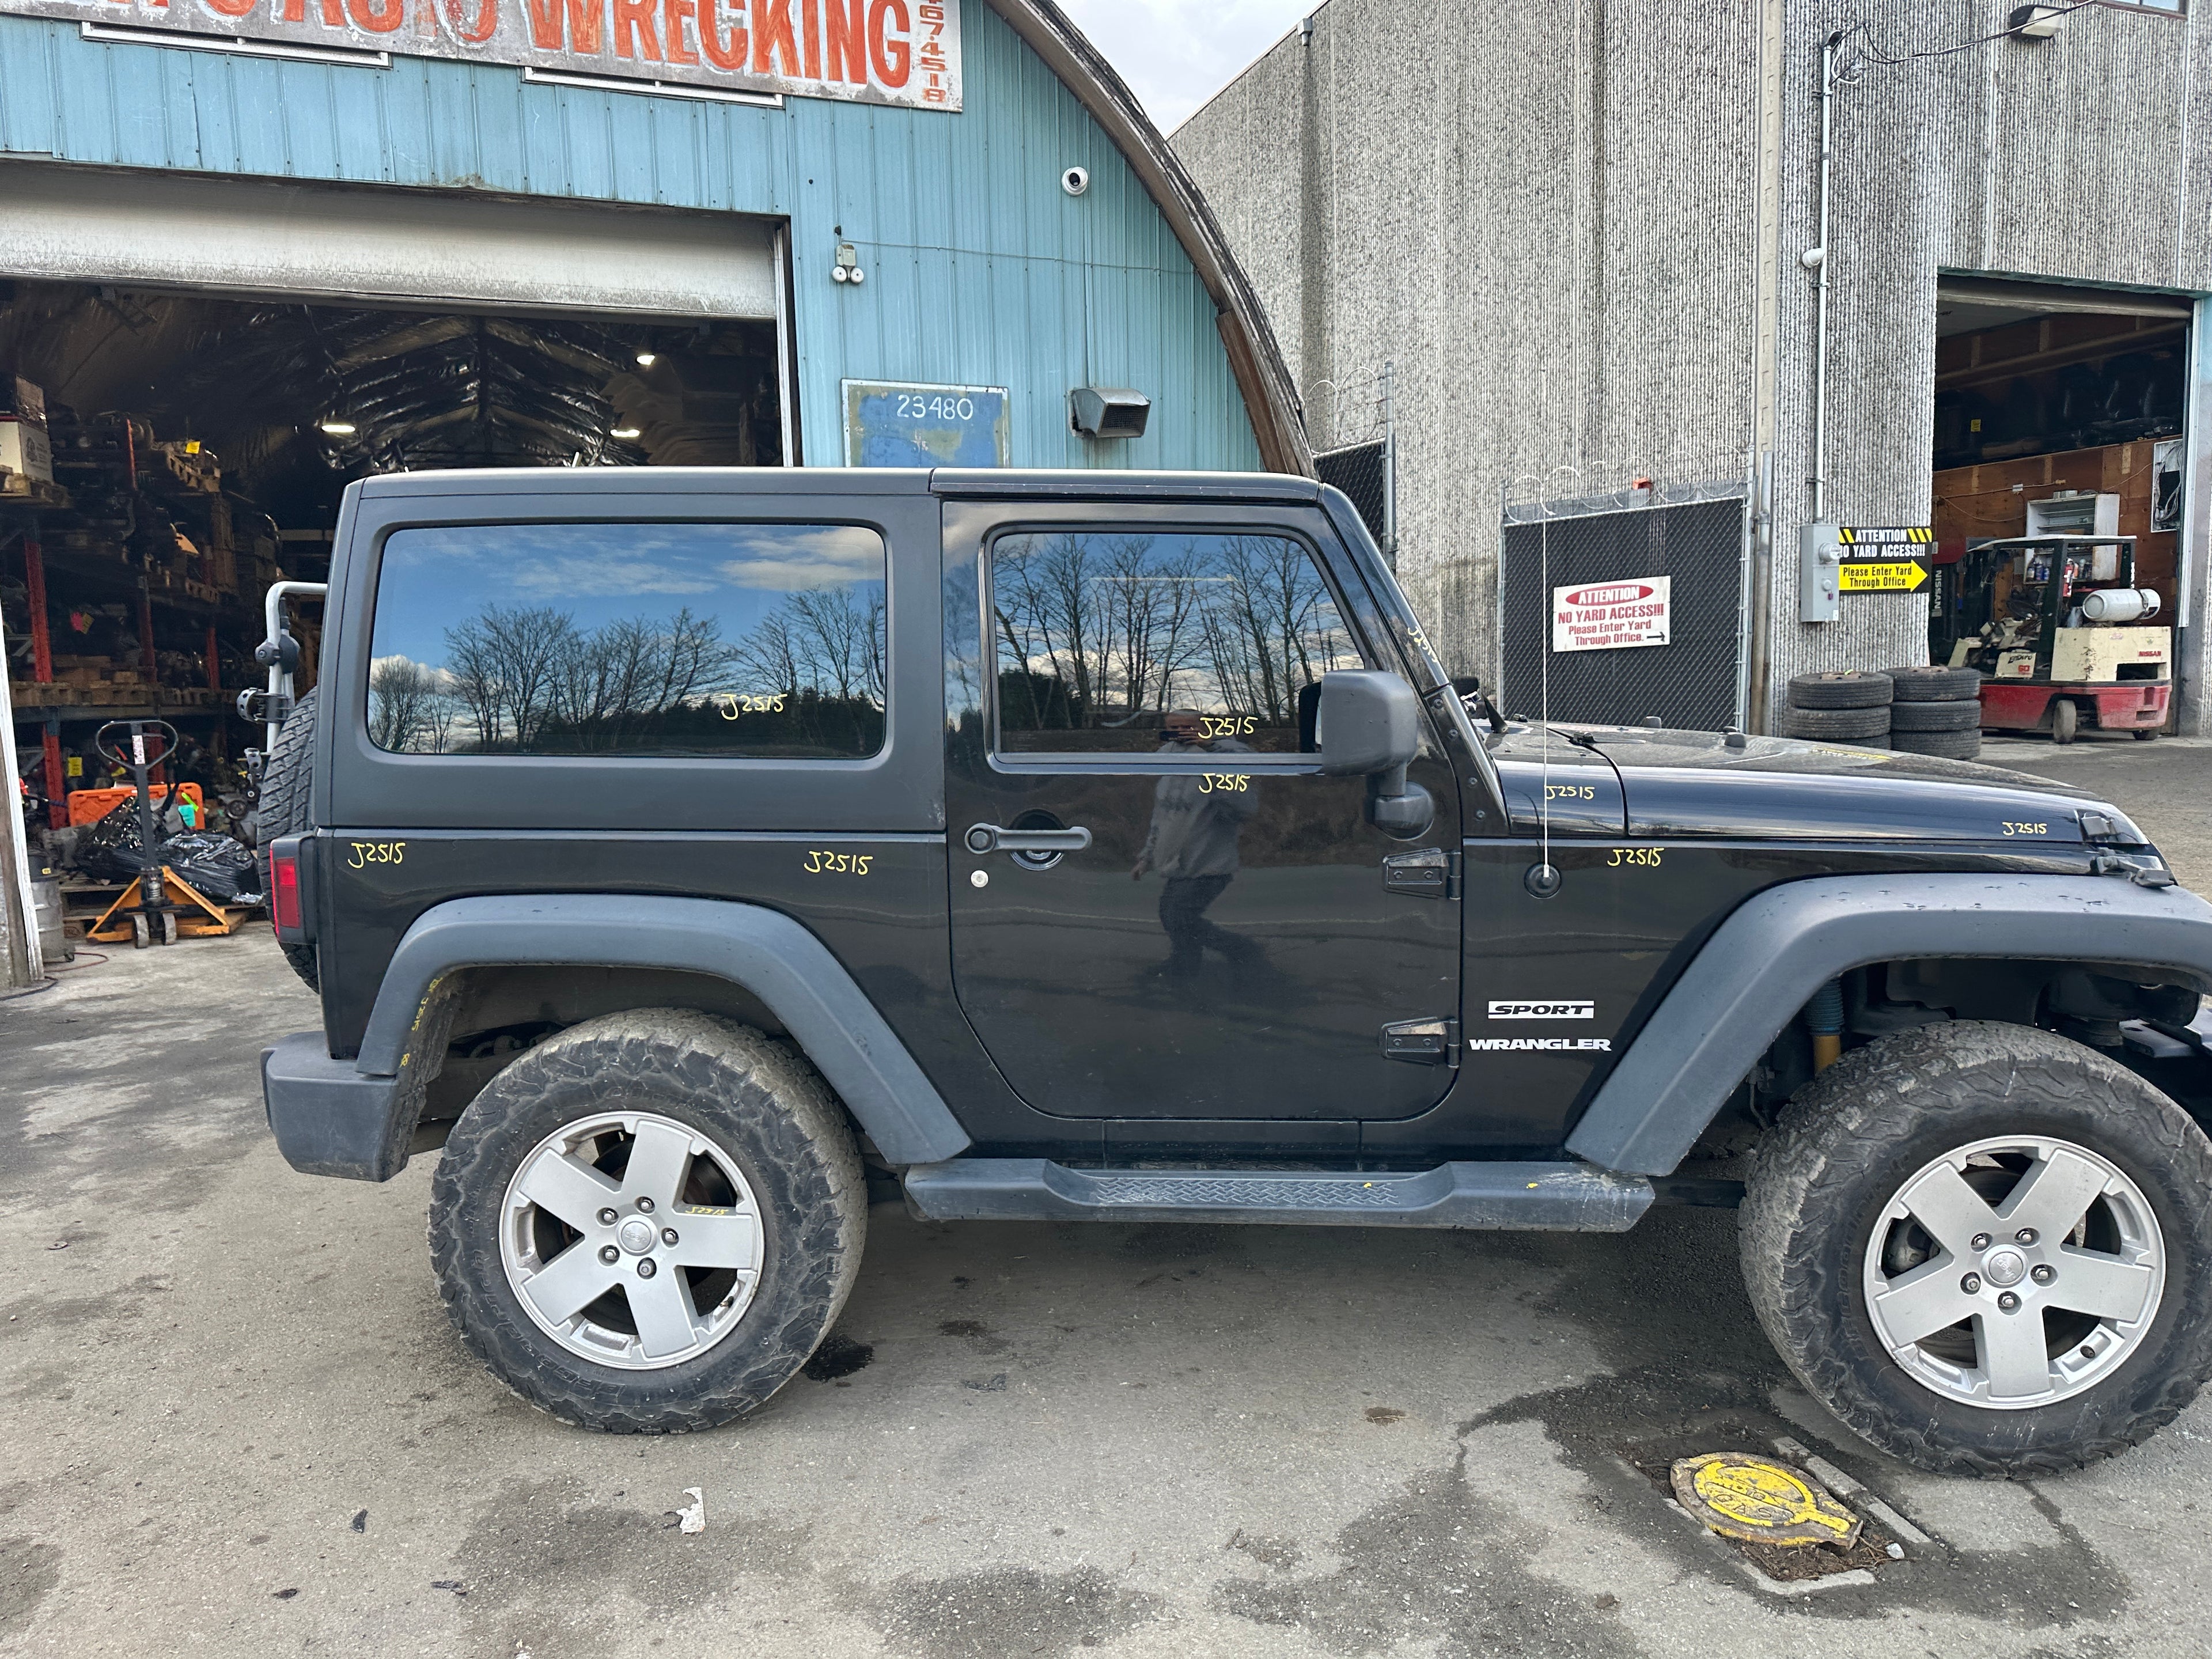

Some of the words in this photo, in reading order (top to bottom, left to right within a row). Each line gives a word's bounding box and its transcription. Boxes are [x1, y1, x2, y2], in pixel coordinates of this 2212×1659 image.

[896, 394, 974, 421] 23480
[1855, 529, 1907, 543] ATTENTION
[1853, 544, 1878, 558] YARD
[1881, 544, 1926, 557] ACCESS!!!
[1843, 567, 1868, 576] Please
[1872, 566, 1892, 576] Enter
[1895, 566, 1912, 575] Yard
[1849, 577, 1880, 588] Through
[1883, 577, 1906, 586] Office
[1934, 569, 1942, 609] NISSAN
[1578, 586, 1640, 605] ATTENTION
[1558, 611, 1573, 624] NO
[1575, 608, 1607, 623] YARD
[1609, 603, 1664, 620] ACCESS!!!
[1569, 625, 1597, 635] Please
[1599, 623, 1625, 633] Enter
[1627, 619, 1652, 631] Yard
[1575, 635, 1611, 646] Through
[721, 693, 788, 721] J2515
[1198, 716, 1259, 740] J2515
[1198, 772, 1251, 794] J2515
[1544, 786, 1595, 800] J2515
[2002, 821, 2048, 836] J2515
[347, 842, 406, 869] J2515
[804, 850, 874, 876] J2515
[1607, 847, 1665, 867] J2515
[1488, 1005, 1594, 1015] SPORT
[1468, 1039, 1612, 1051] WRANGLER
